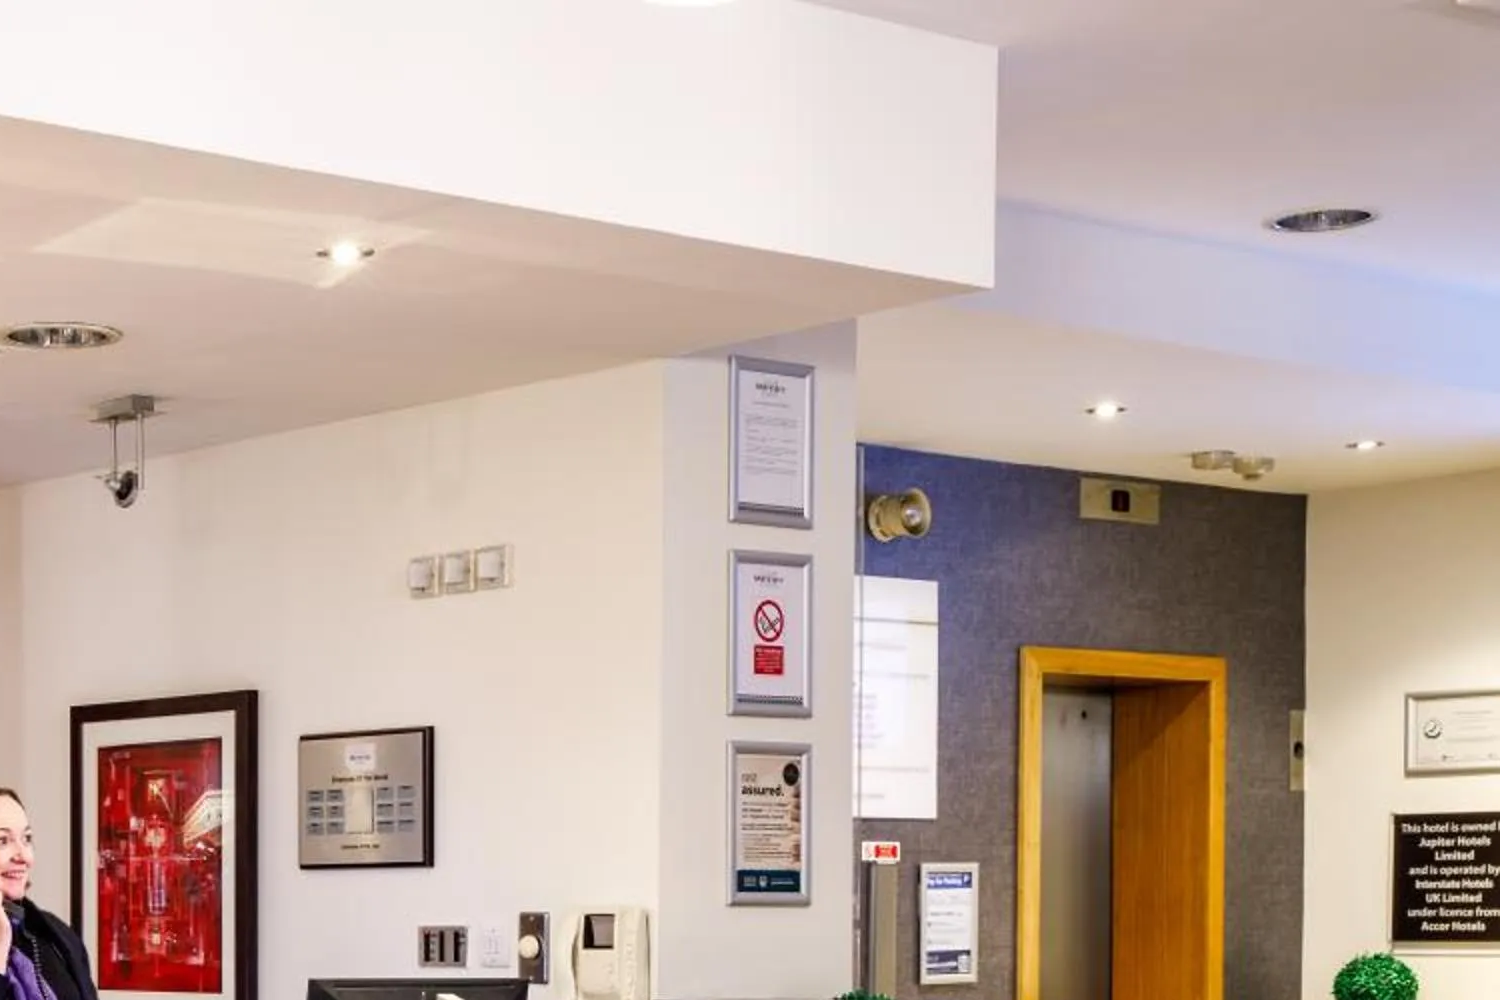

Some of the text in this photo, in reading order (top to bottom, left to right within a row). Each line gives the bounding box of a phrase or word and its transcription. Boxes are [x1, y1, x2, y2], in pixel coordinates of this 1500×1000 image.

[1402, 822, 1421, 833] This
[1422, 821, 1449, 833] hotel
[1450, 821, 1460, 833] is
[1461, 820, 1497, 833] owned
[1418, 835, 1491, 850] Jupiter Hotels
[1434, 849, 1475, 861] Limited
[1408, 863, 1500, 877] and is operated by
[1415, 877, 1494, 890] Interstate Hotels
[1425, 891, 1483, 904] UK Limited
[1407, 906, 1437, 918] under
[1439, 906, 1474, 918] licence
[1421, 921, 1486, 932] Accor Hotels
